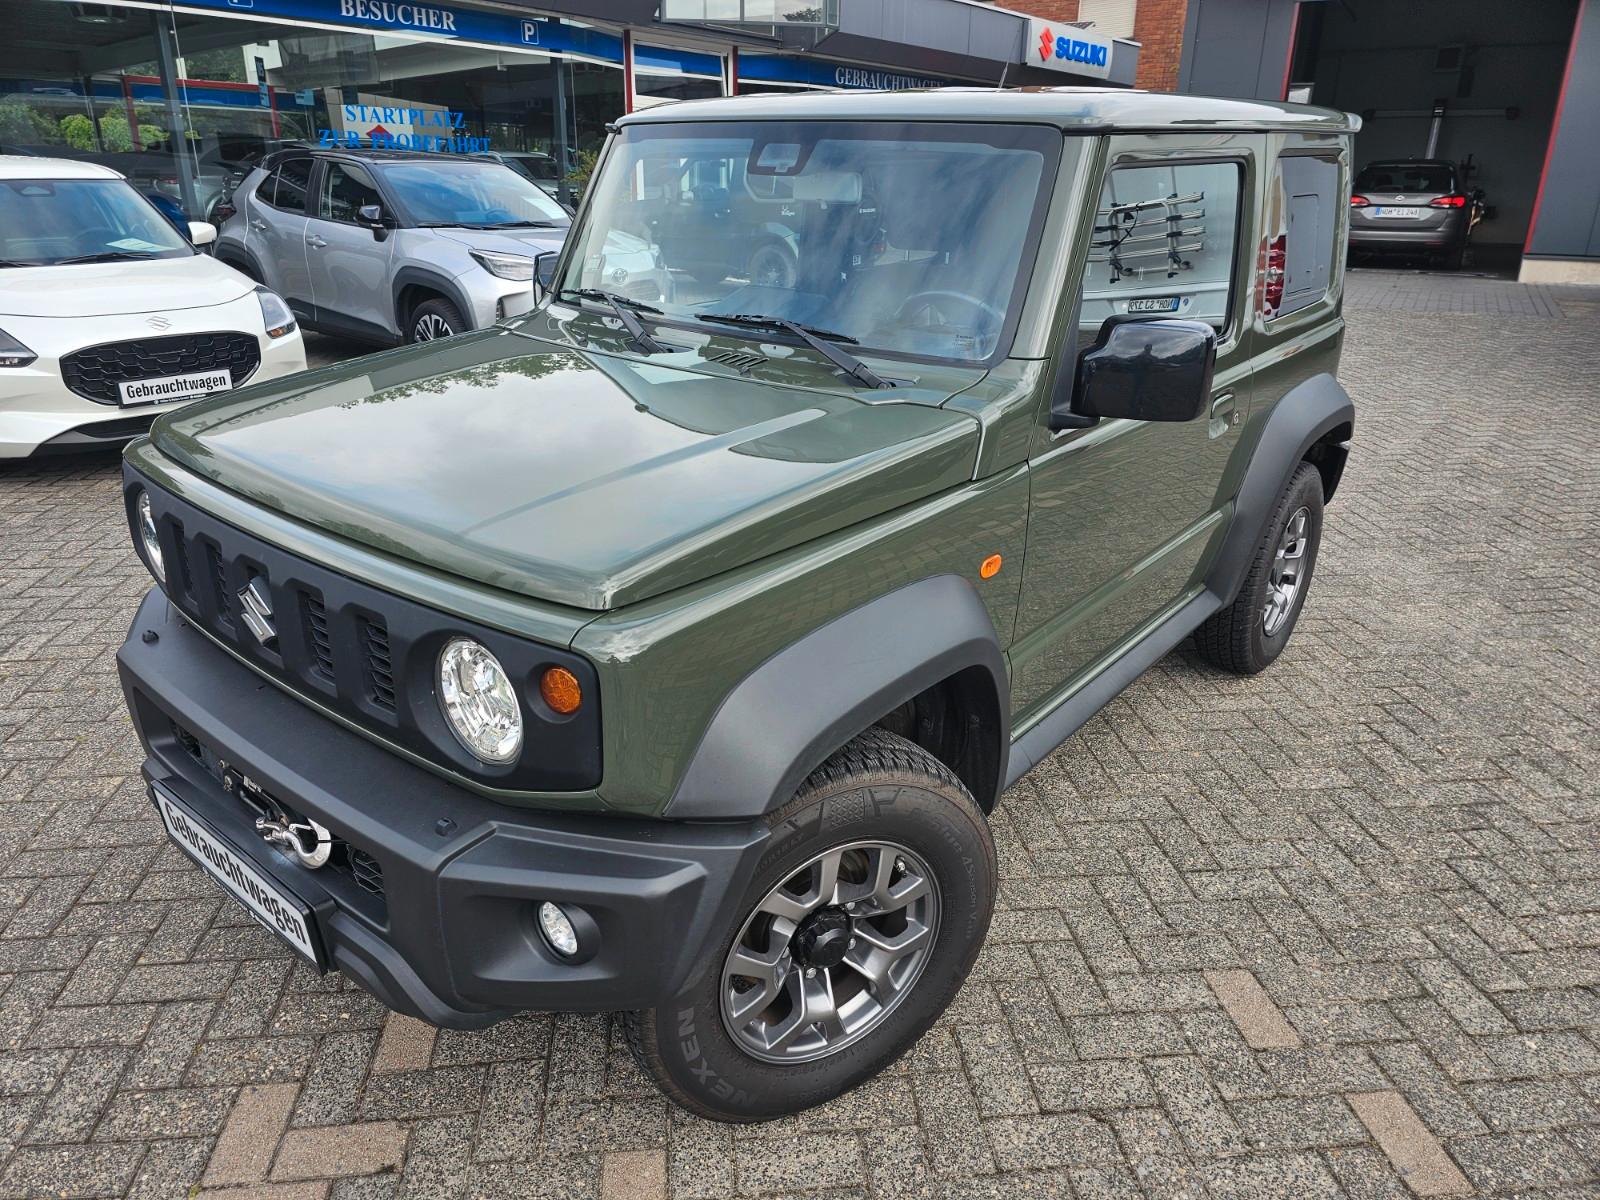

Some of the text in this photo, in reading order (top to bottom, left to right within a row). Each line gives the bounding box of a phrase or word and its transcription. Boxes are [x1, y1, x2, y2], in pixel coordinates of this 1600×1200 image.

[340, 0, 456, 31] BESUCHER
[1055, 36, 1107, 67] SUZUKI
[345, 104, 466, 129] STARTPLATZ
[319, 129, 491, 153] ZUR PROBEFAHRT
[126, 375, 227, 399] Gebrauchtwagen
[165, 802, 307, 945] Gebrauchtwagen
[677, 1007, 760, 1107] NEXEN
